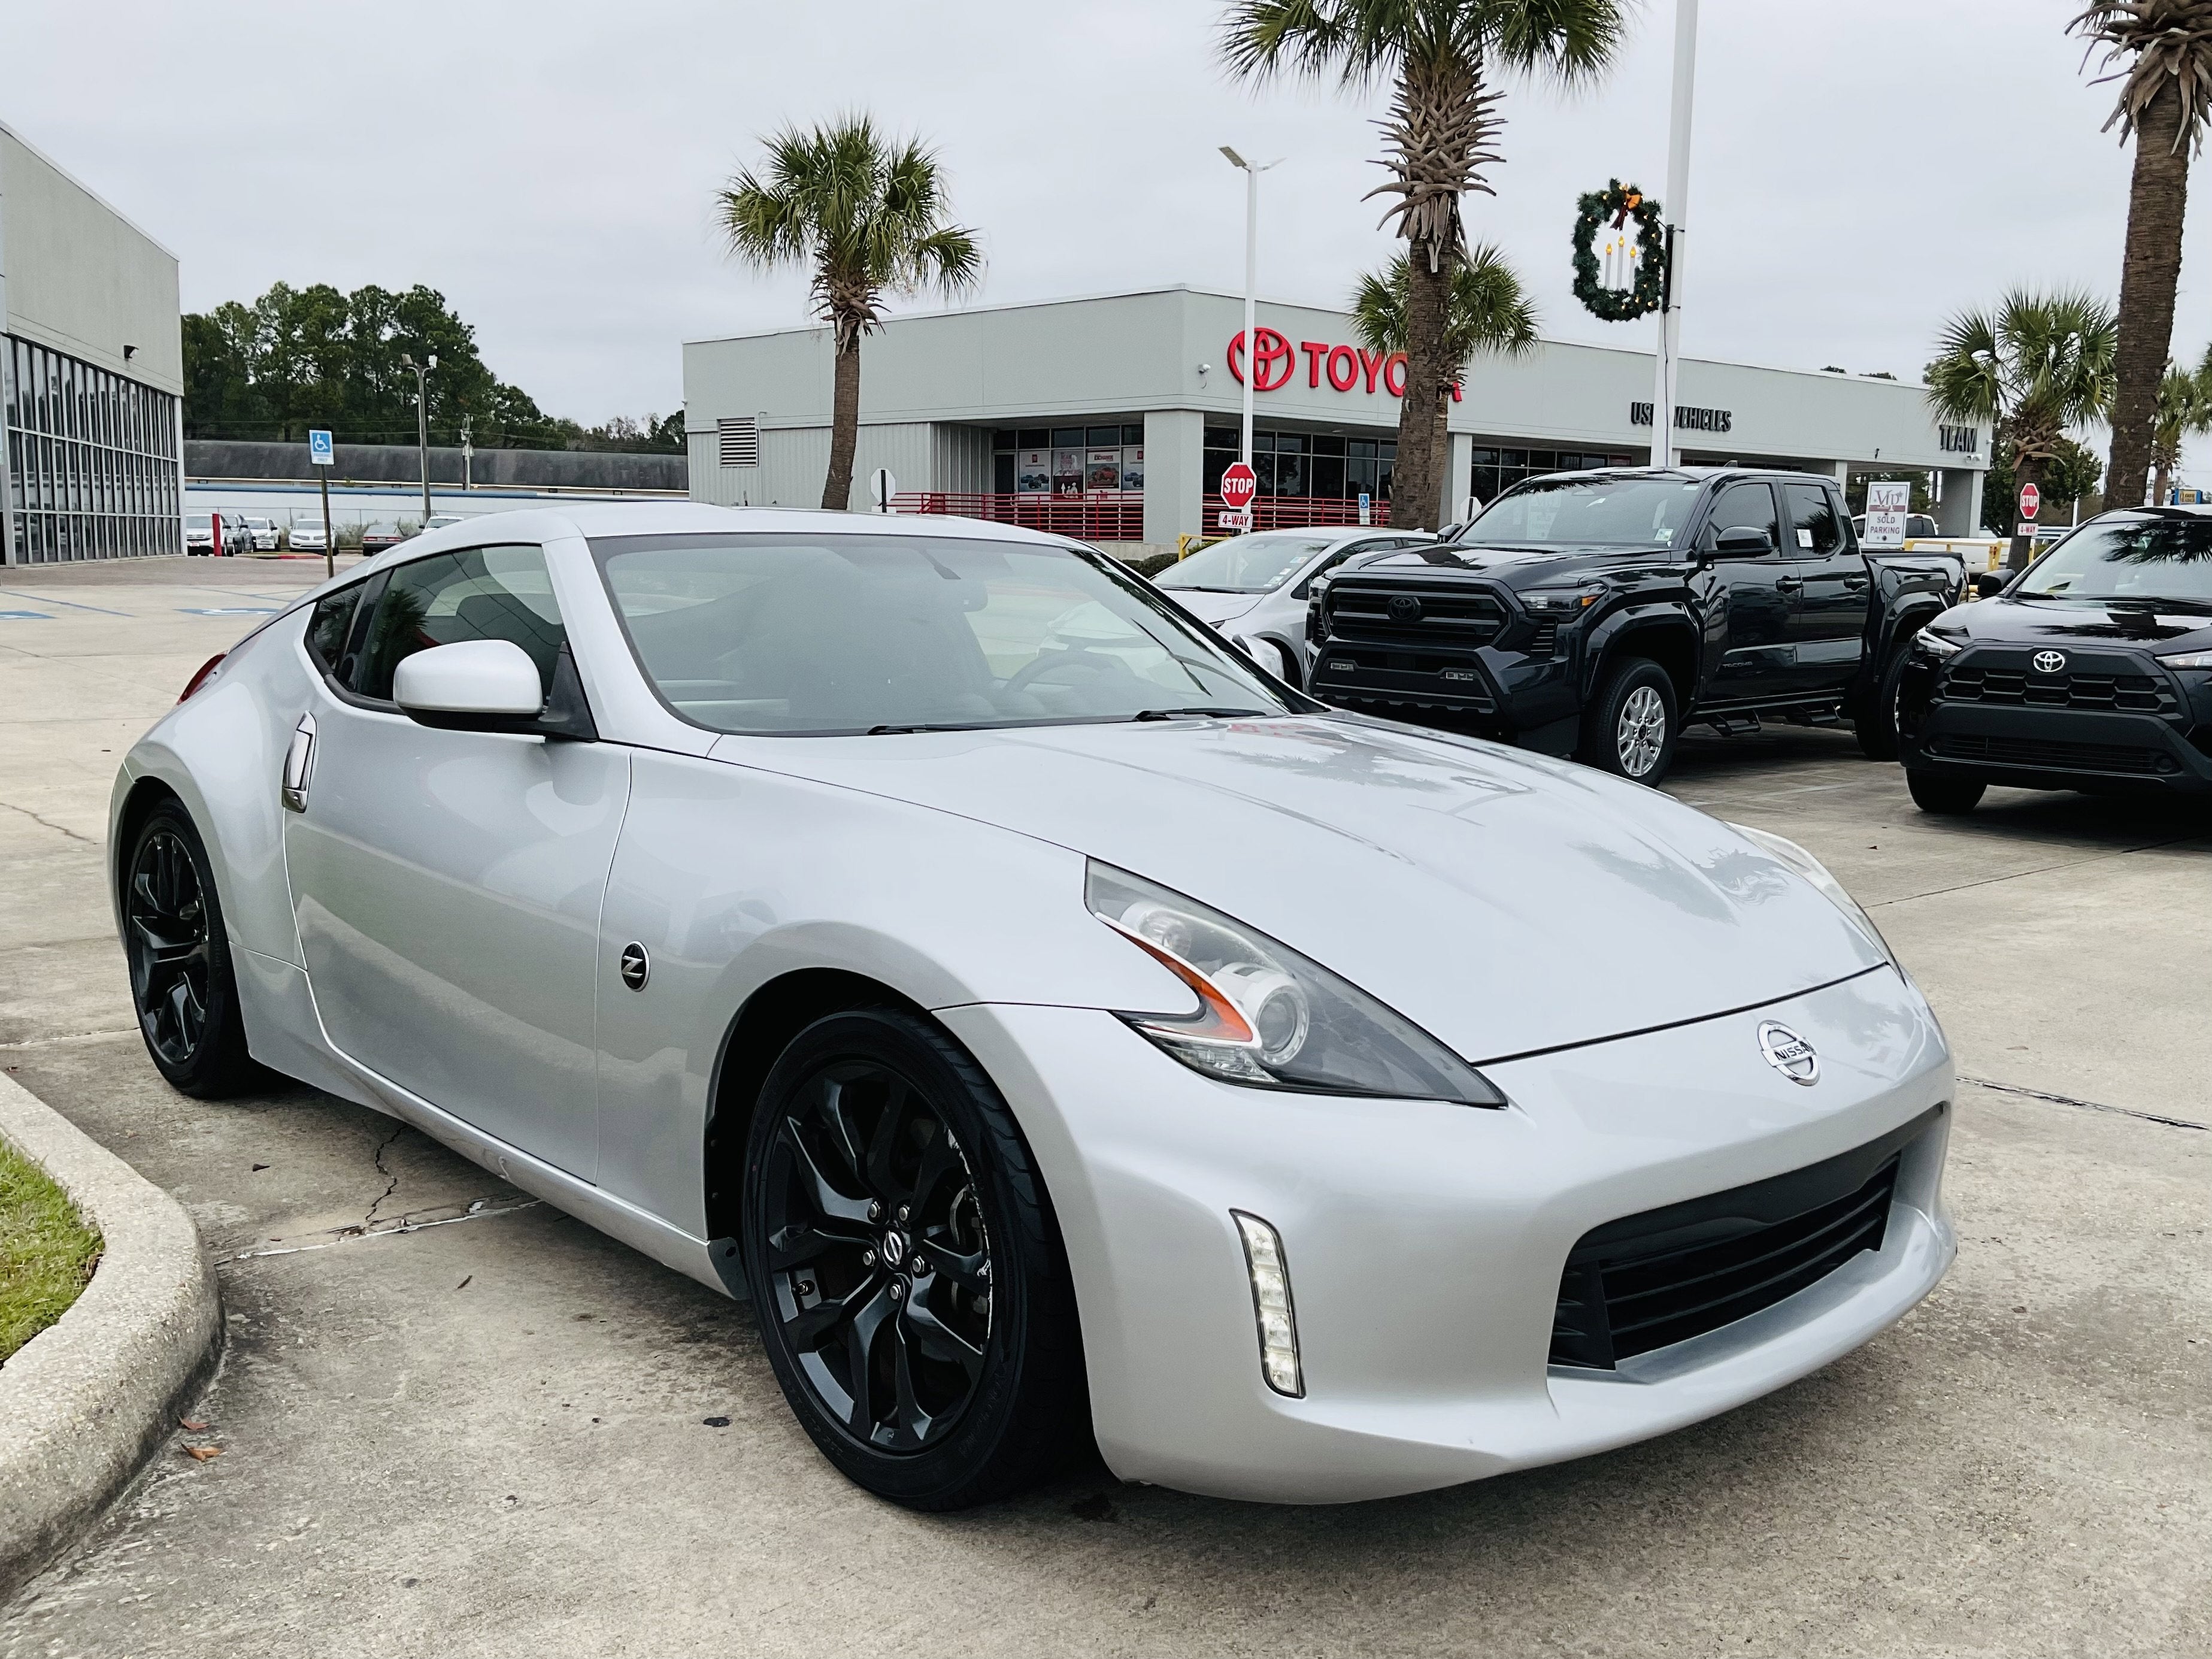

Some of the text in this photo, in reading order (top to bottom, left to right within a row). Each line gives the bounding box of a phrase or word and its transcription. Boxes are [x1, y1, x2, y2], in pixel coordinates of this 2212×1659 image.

[1301, 341, 1462, 402] TOYO
[1939, 424, 1977, 453] TEAM
[1223, 477, 1253, 494] STOP
[2021, 495, 2038, 507] STOP
[1222, 514, 1249, 526] 4-WAY
[1877, 516, 1895, 524] SOLD
[1869, 526, 1900, 534] PARKING
